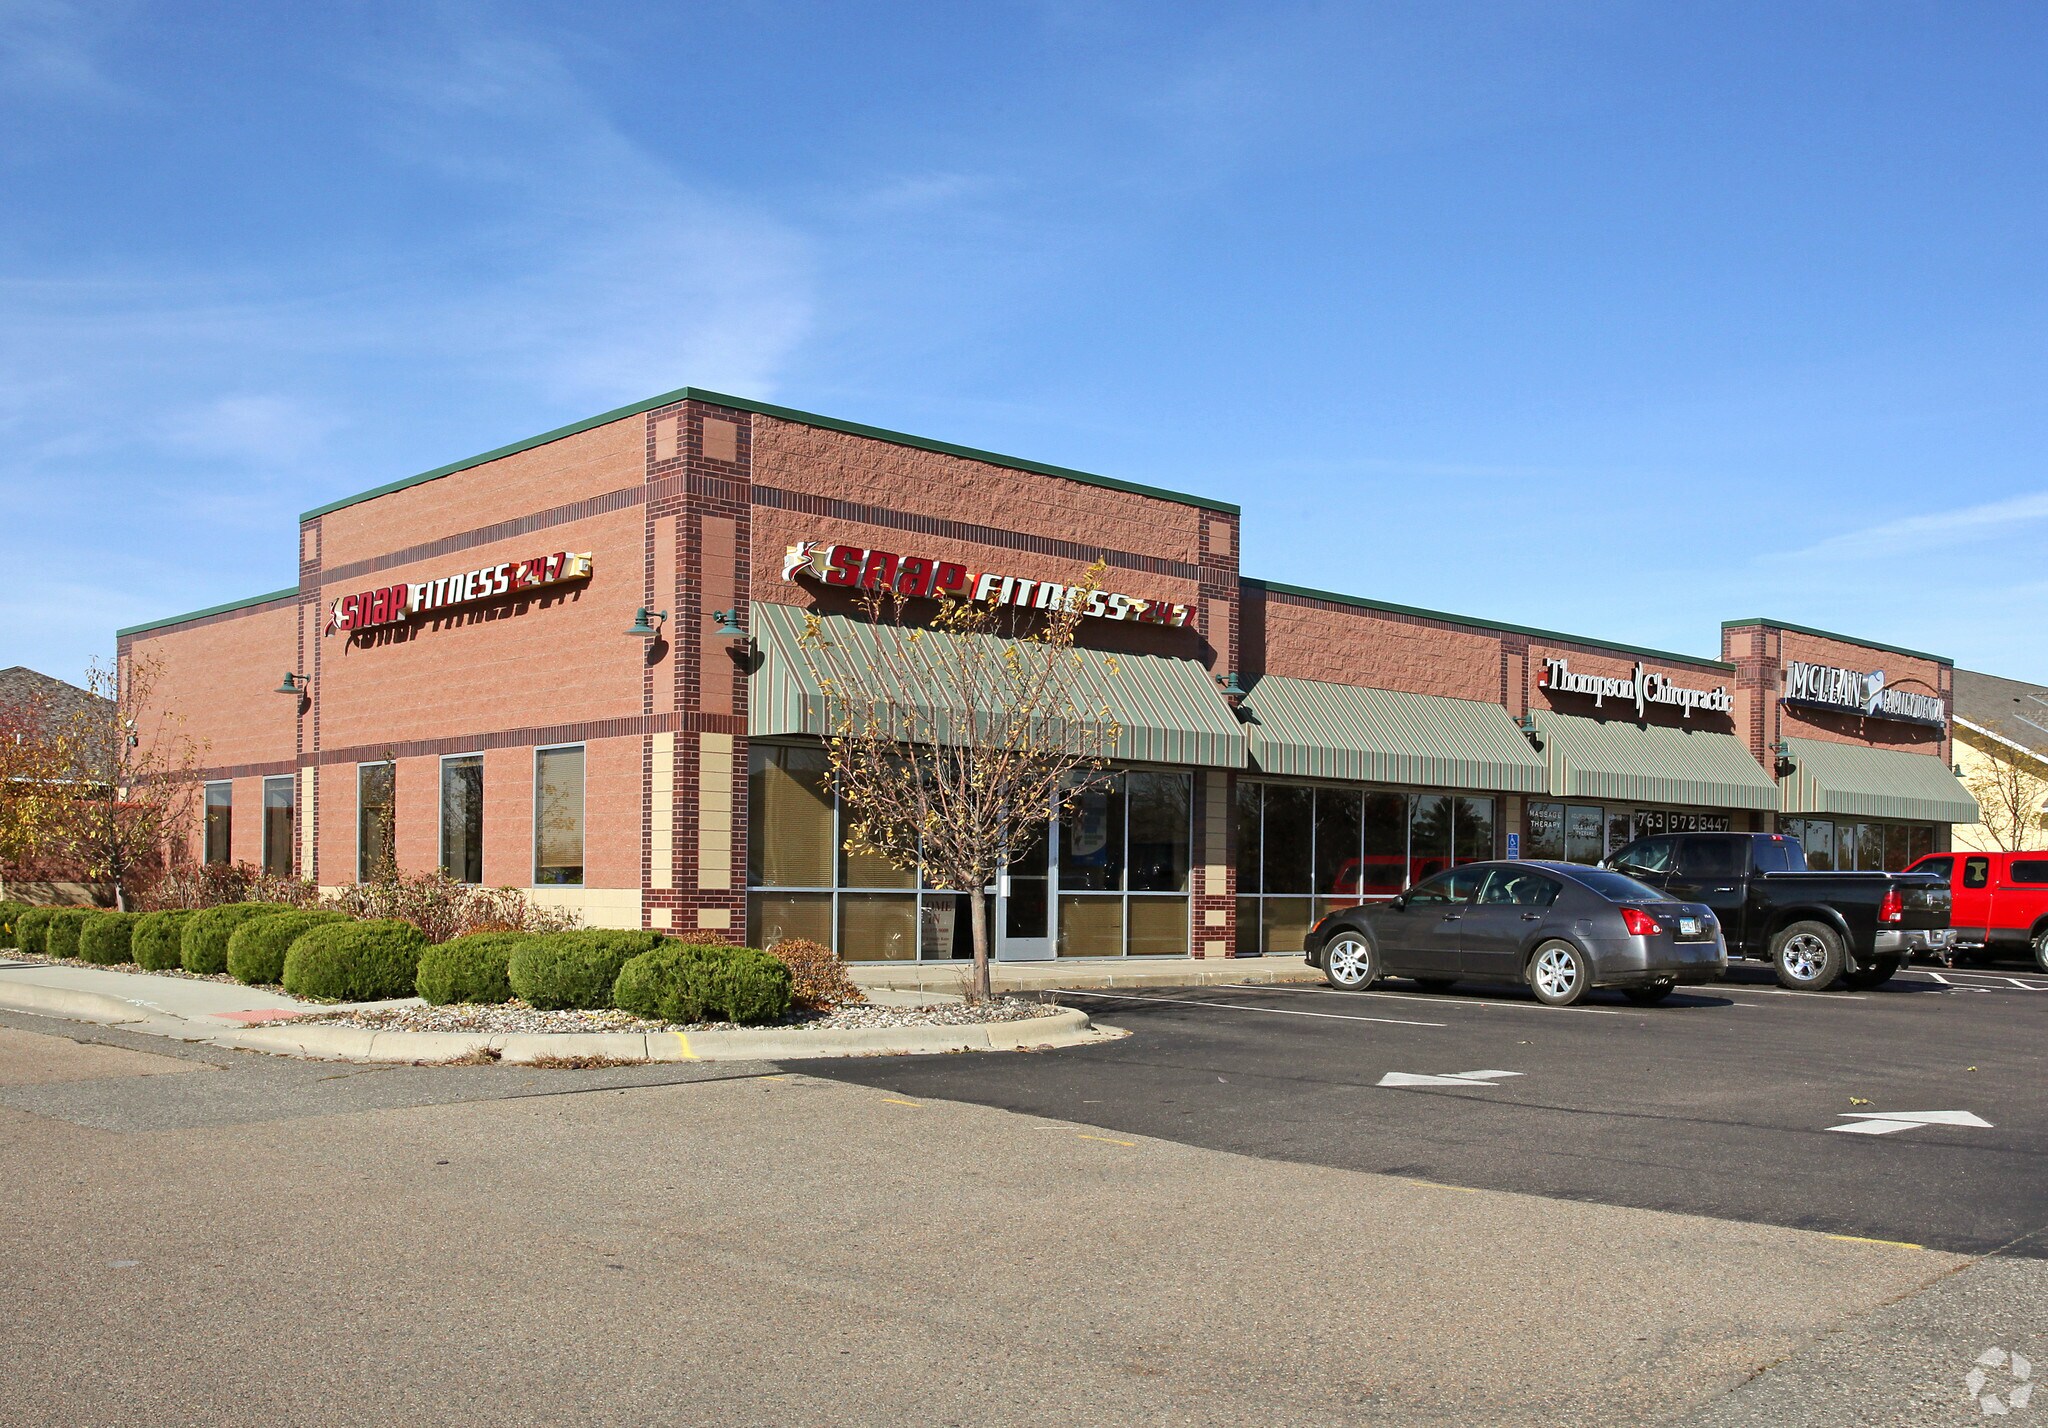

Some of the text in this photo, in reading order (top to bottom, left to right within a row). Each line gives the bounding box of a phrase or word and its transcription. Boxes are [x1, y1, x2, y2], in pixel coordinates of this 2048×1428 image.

[412, 563, 510, 612] FITNESS
[975, 573, 1129, 620] FITNESS
[1547, 658, 1734, 718] Thompson Chiropractic
[1883, 689, 1914, 716] FAMILY
[1530, 820, 1561, 828] THERAPY
[1637, 812, 1729, 832] 763 972 3447
